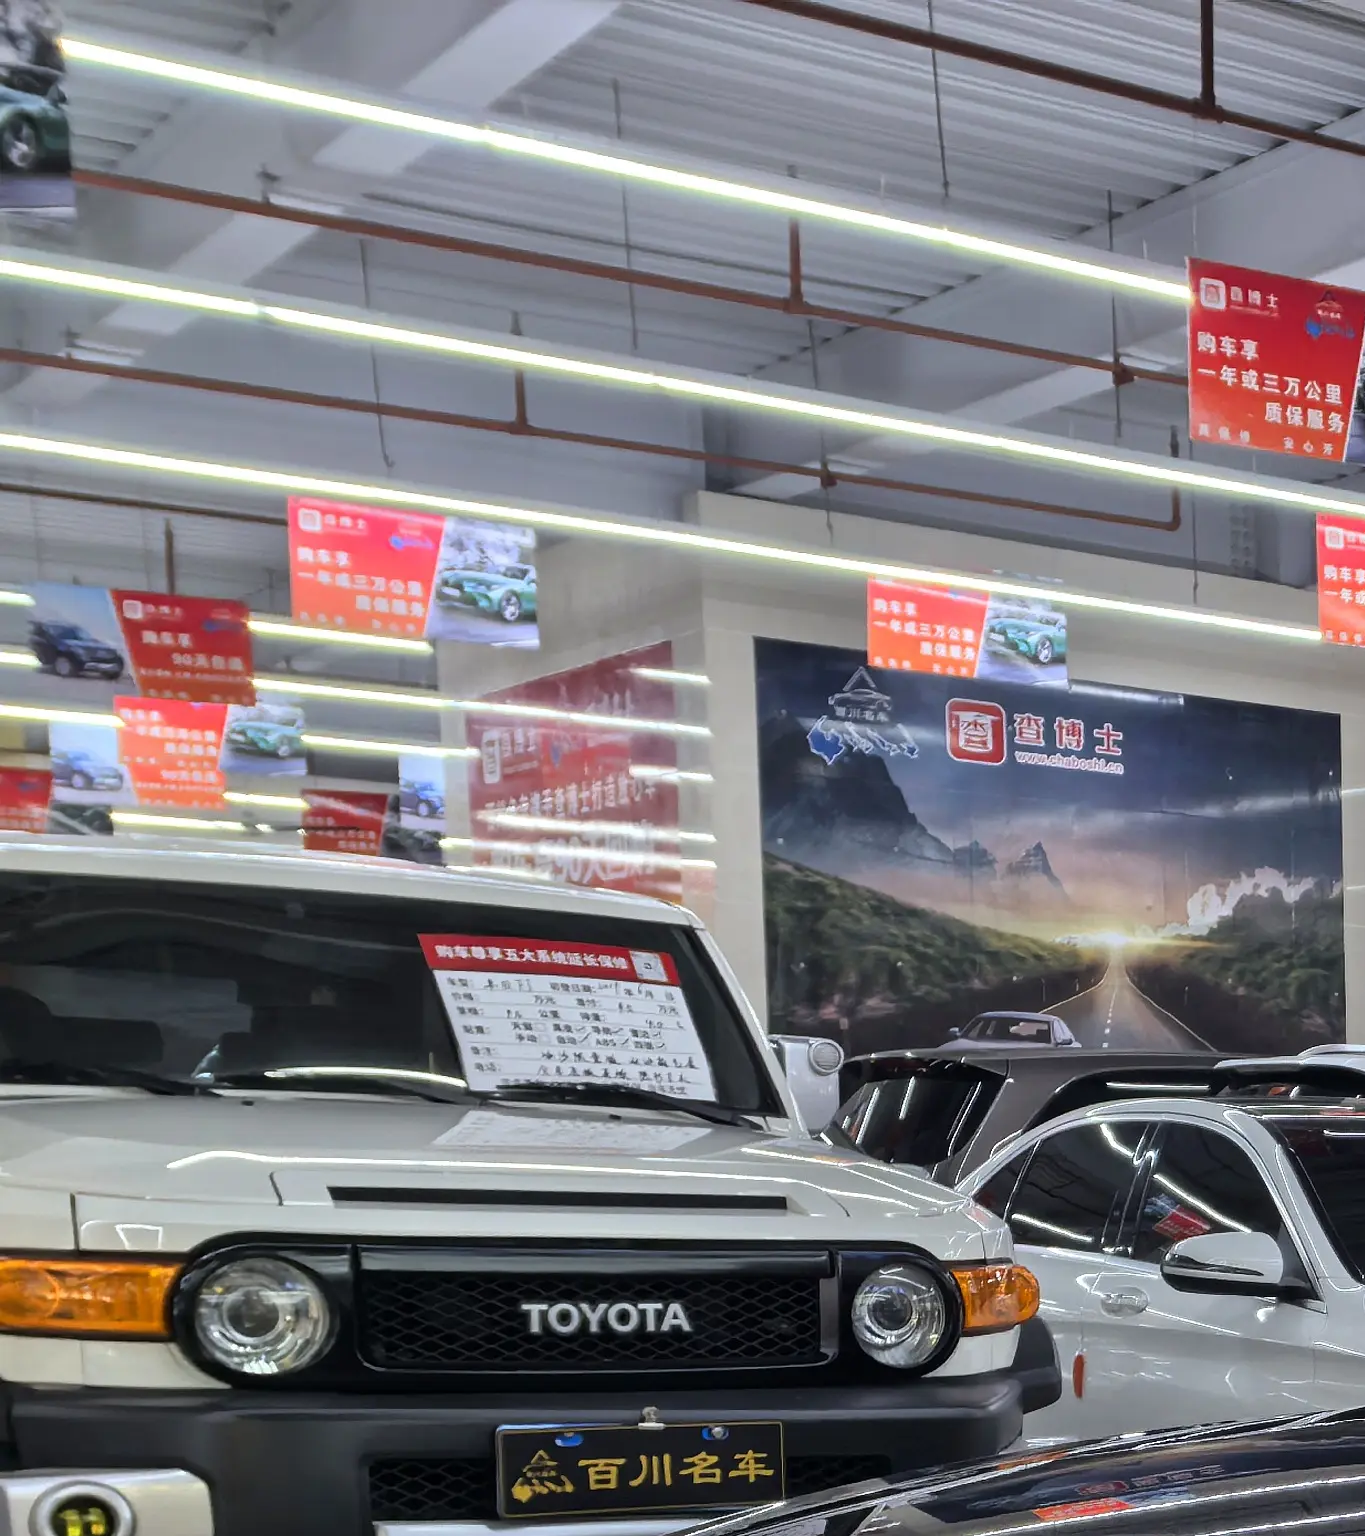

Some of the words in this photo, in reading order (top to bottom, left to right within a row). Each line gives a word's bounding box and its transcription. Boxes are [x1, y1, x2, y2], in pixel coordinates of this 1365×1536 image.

[1197, 331, 1258, 360] 购车享
[1197, 365, 1343, 405] 一年或三万公里
[1264, 402, 1345, 433] 质保服务
[1013, 712, 1124, 756] 查博士
[1015, 750, 1125, 775] www.chaboshi.cn
[520, 1302, 694, 1334] TOYOTA
[578, 1449, 775, 1490] 百川名车
